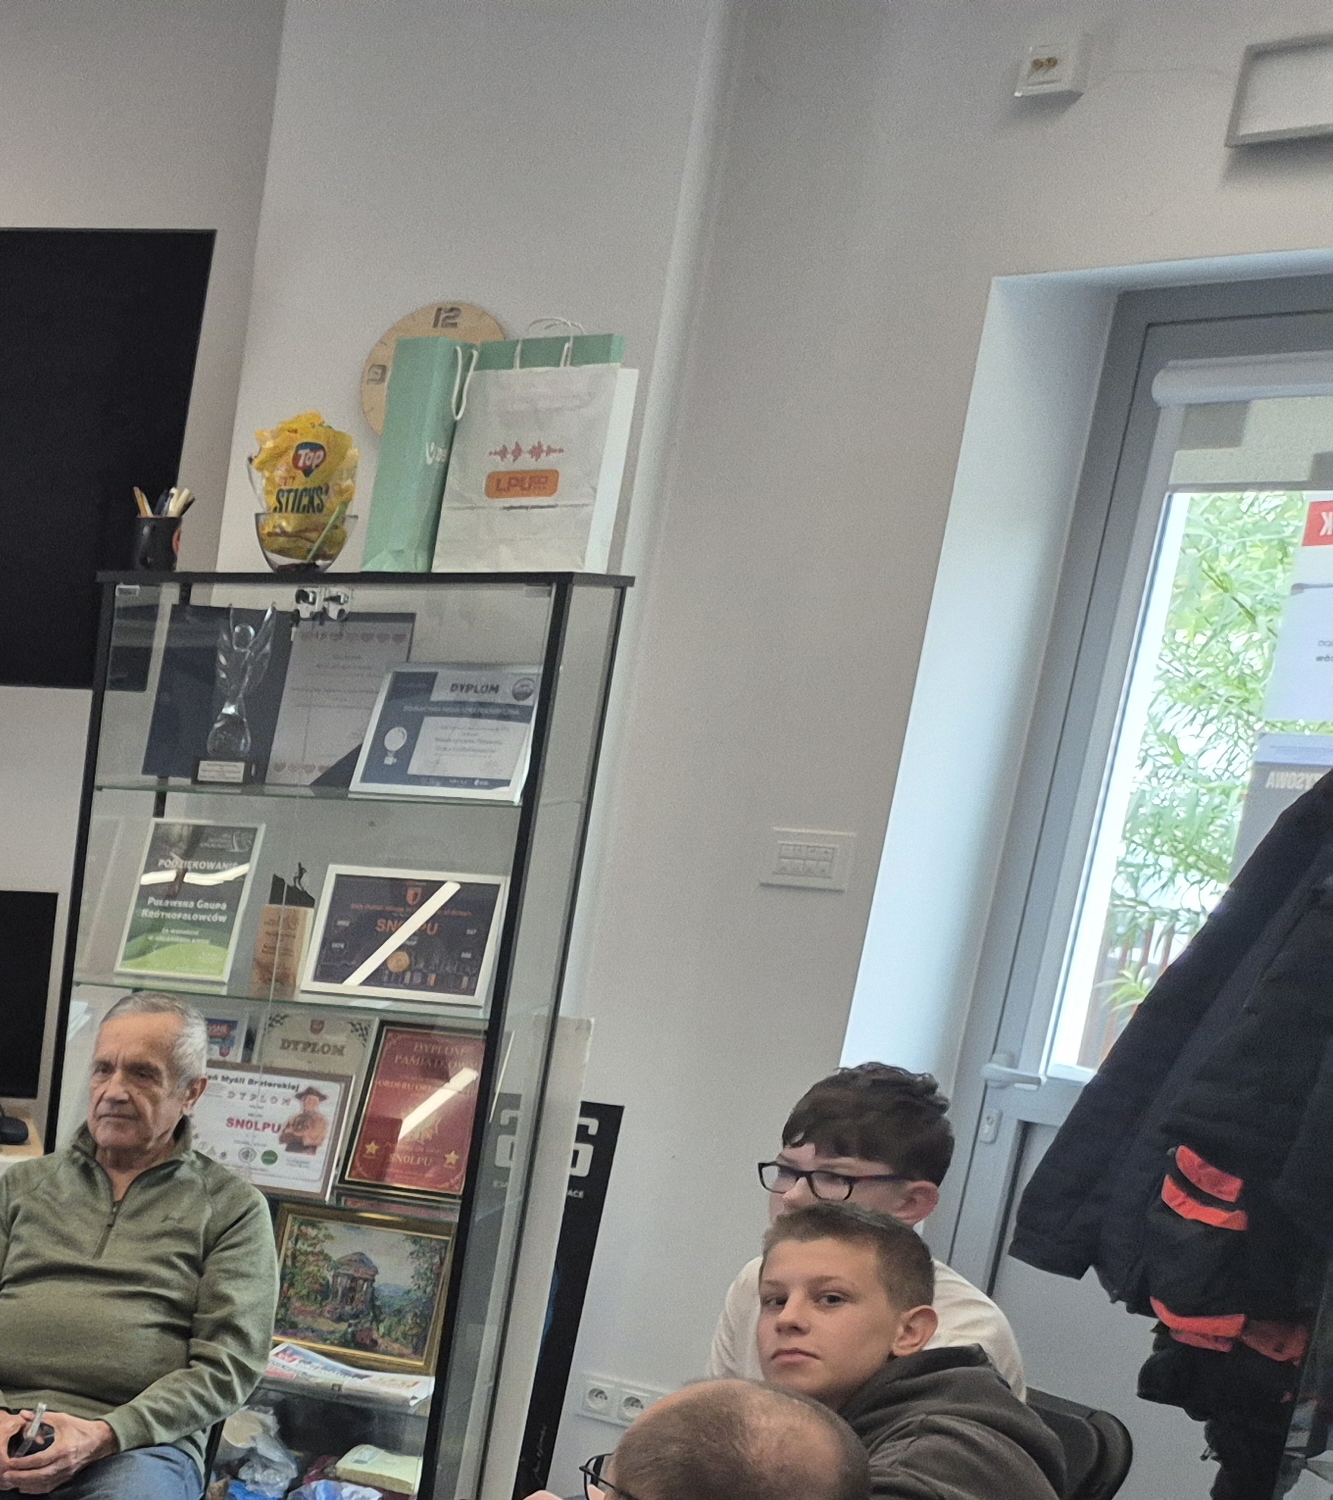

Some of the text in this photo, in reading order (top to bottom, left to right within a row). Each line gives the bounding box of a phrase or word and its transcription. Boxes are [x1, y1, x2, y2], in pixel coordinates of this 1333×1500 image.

[433, 307, 461, 329] 12
[449, 682, 500, 695] DYPLOM
[279, 1039, 346, 1056] DYPLOM
